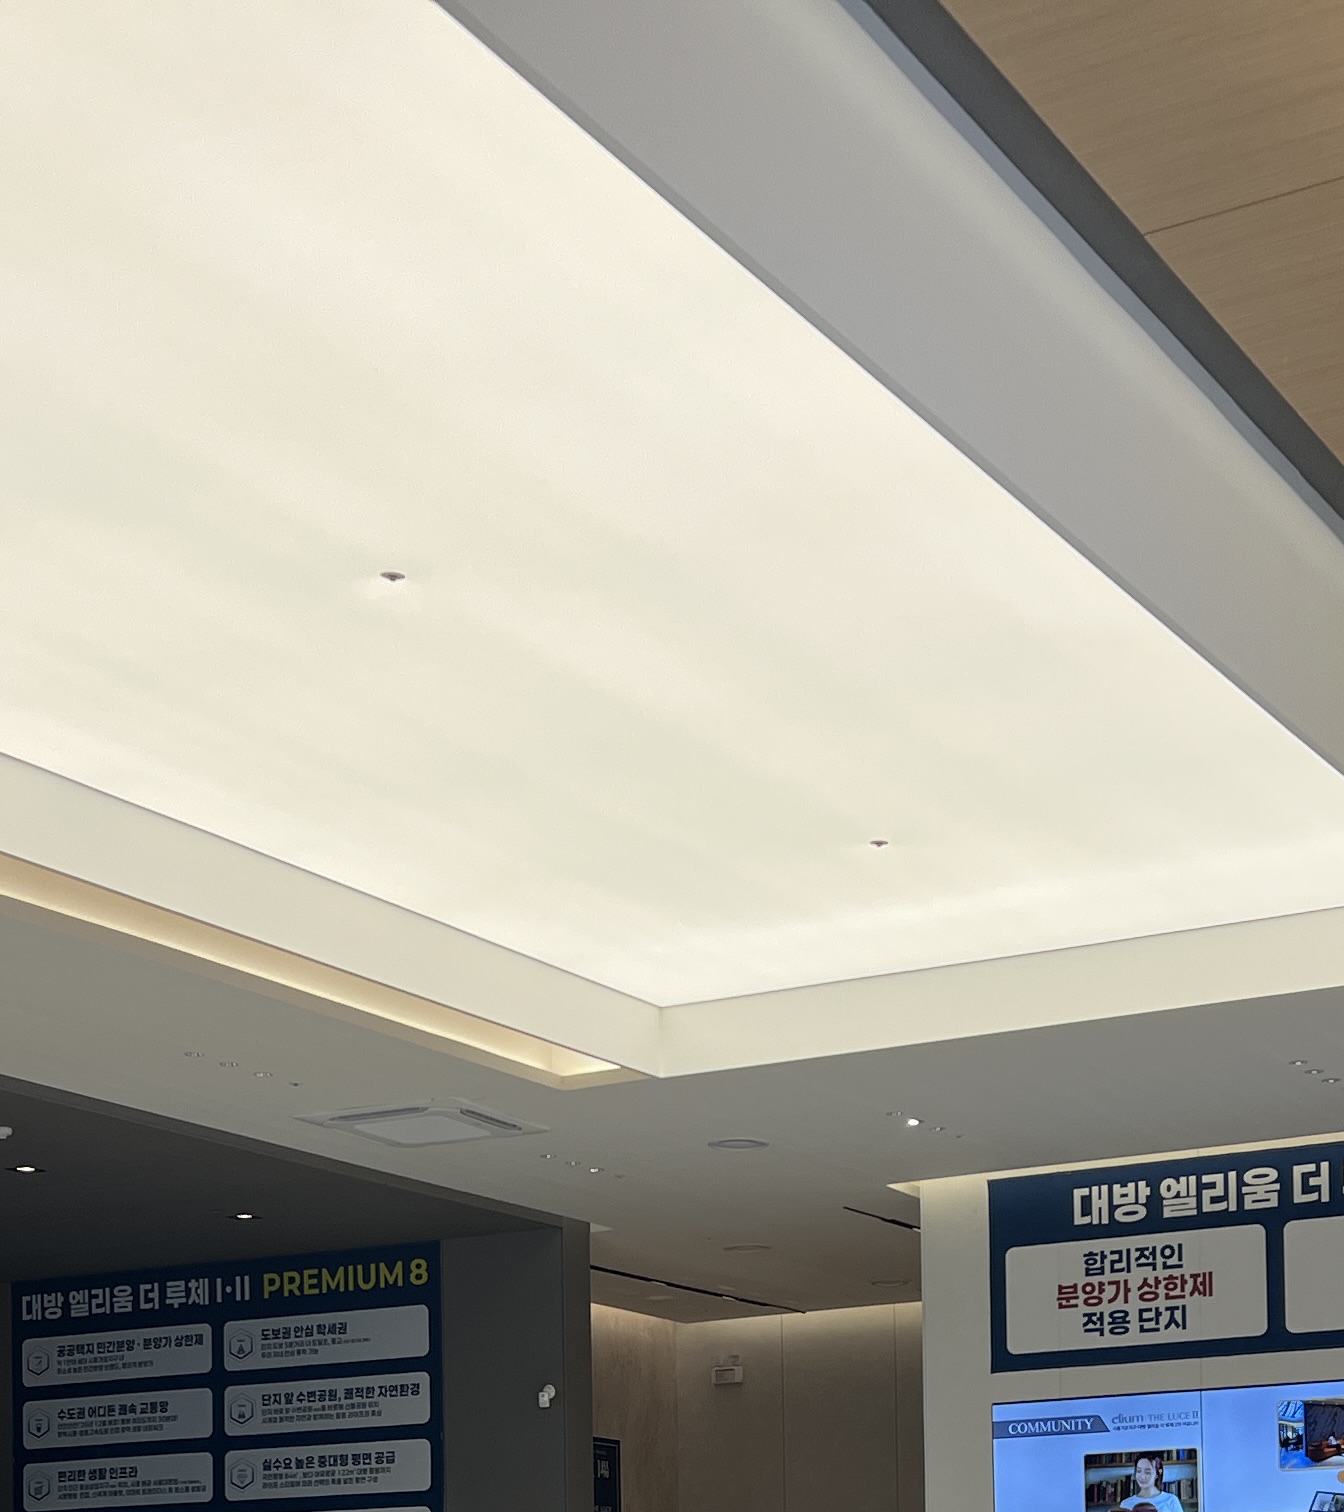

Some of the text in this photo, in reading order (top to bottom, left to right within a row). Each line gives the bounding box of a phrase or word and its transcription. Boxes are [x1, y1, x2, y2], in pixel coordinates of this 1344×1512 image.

[1073, 1180, 1150, 1225] 대방
[1158, 1167, 1280, 1218] 엘리움
[1292, 1161, 1330, 1205] 더
[1084, 1243, 1184, 1277] 합리적인
[21, 1292, 64, 1321] 대방
[68, 1285, 134, 1318] 엘리움
[139, 1282, 160, 1311] 더
[165, 1278, 210, 1309] 루체
[262, 1260, 403, 1300] PREMIUM
[409, 1258, 429, 1286] 8
[1056, 1271, 1214, 1310] 분양가 상한제
[261, 1327, 291, 1341] 도보권
[293, 1325, 314, 1339] 안심
[1082, 1304, 1188, 1337] 적용 단지
[174, 1333, 204, 1348] 상한제
[261, 1393, 281, 1407] 단지
[1007, 1417, 1094, 1434] COMMUNITY
[1111, 1411, 1144, 1425] elium
